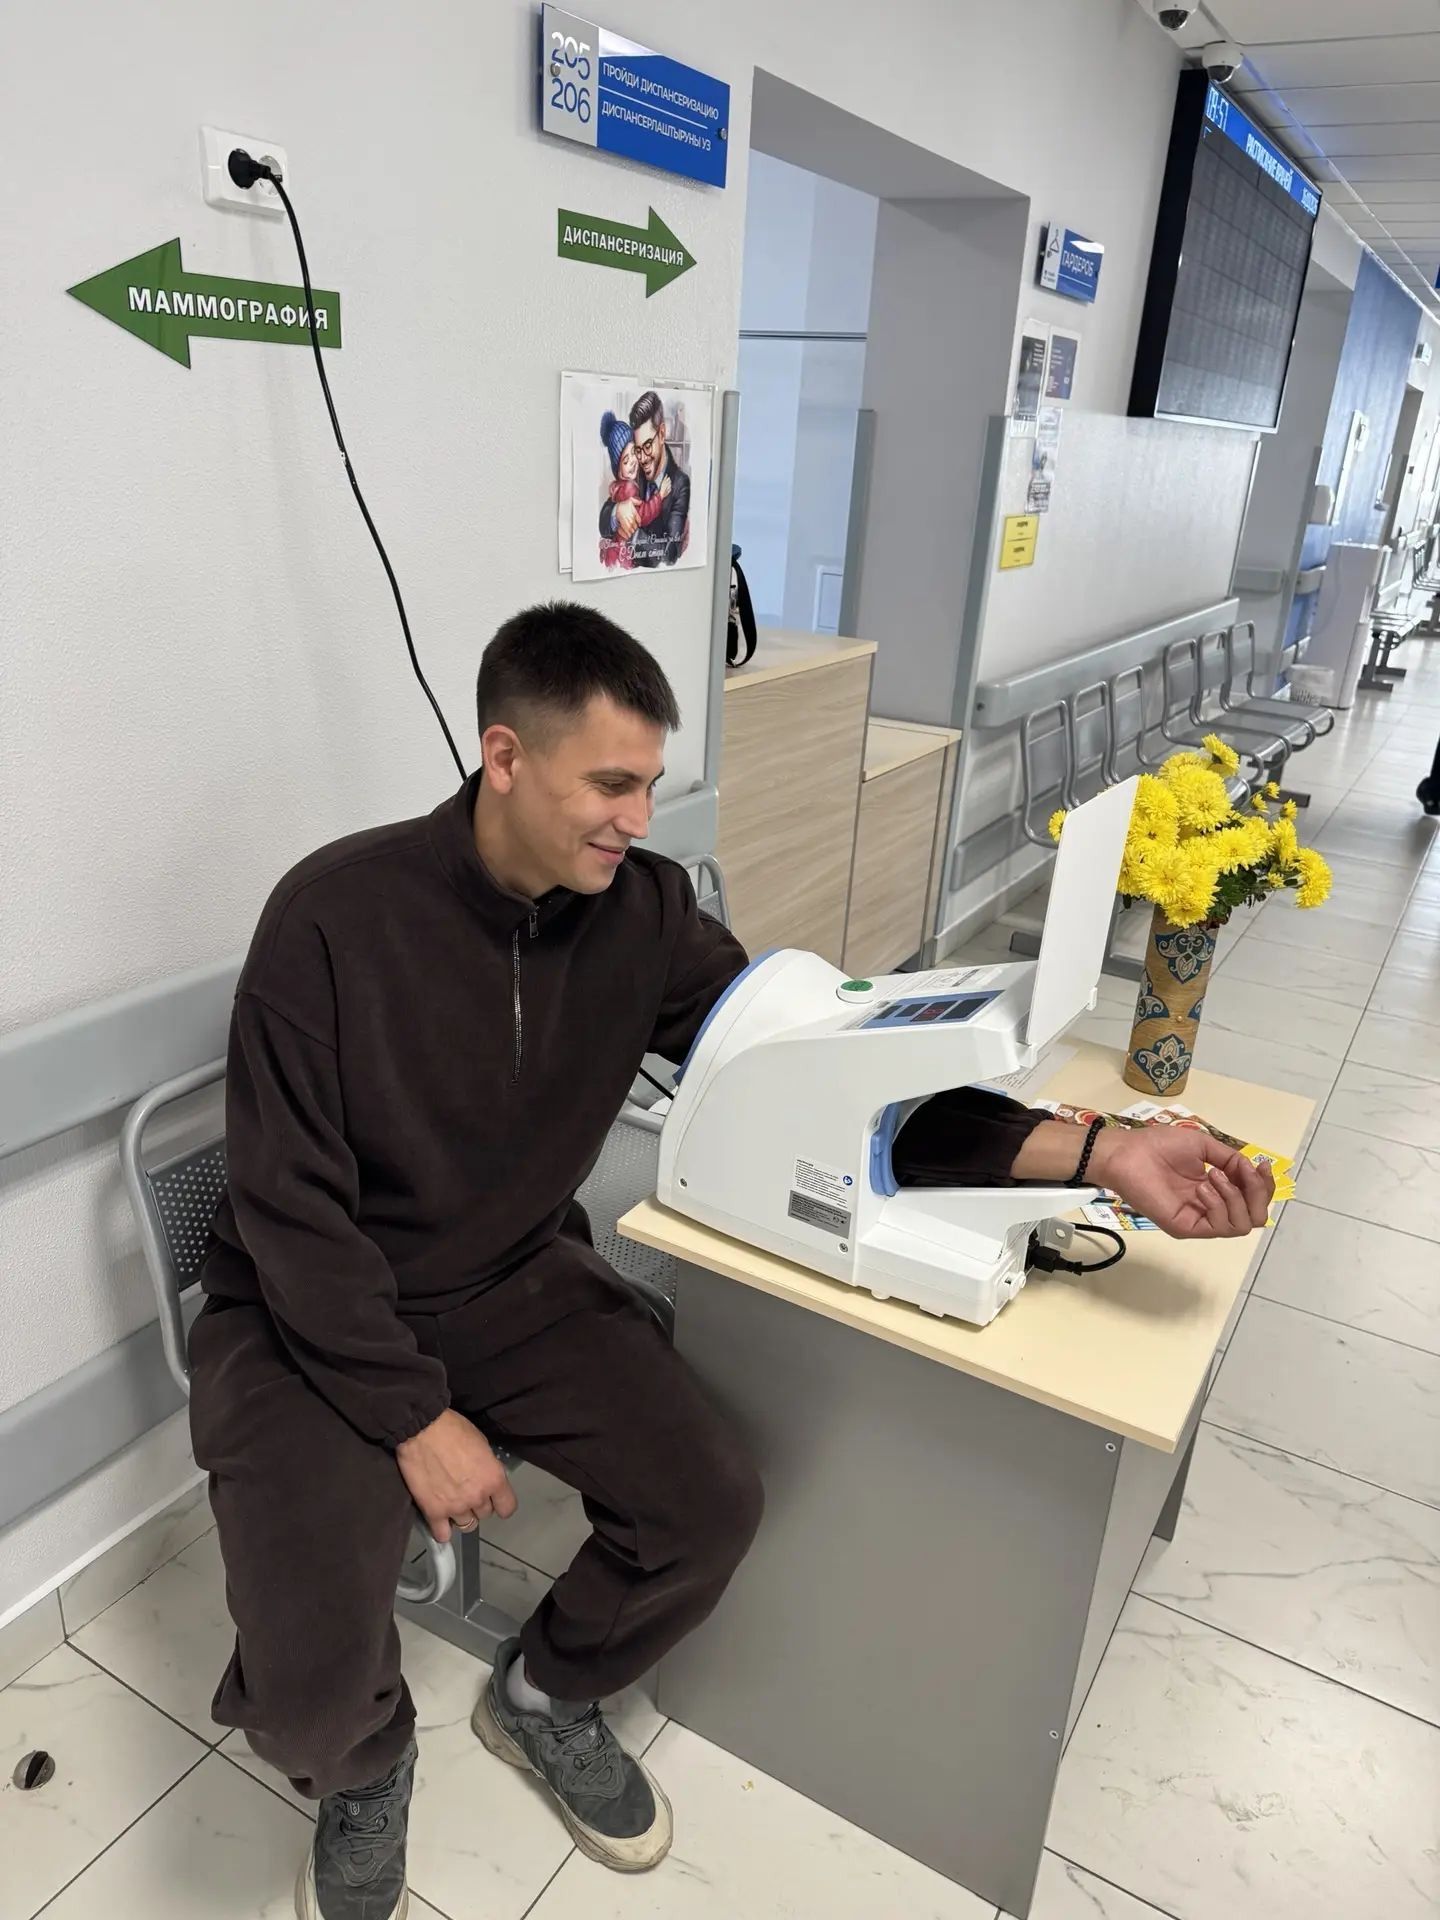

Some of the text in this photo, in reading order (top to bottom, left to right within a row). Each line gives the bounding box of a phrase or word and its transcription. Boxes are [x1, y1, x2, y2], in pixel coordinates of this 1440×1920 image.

[551, 31, 591, 81] 205
[551, 77, 591, 124] 206
[602, 62, 719, 121] ПРОЙДИ ДИСПАНСЕРИЗАЦИЮ
[601, 101, 712, 152] ДИСПАНСЕРЛАШТЫРУНЫ УЗ
[563, 225, 684, 266] ДИСПАНСЕРИЗАЦИЯ
[1062, 250, 1095, 278] ГАРДЕРОБ
[127, 286, 329, 331] МАММОГРАФИЯ
